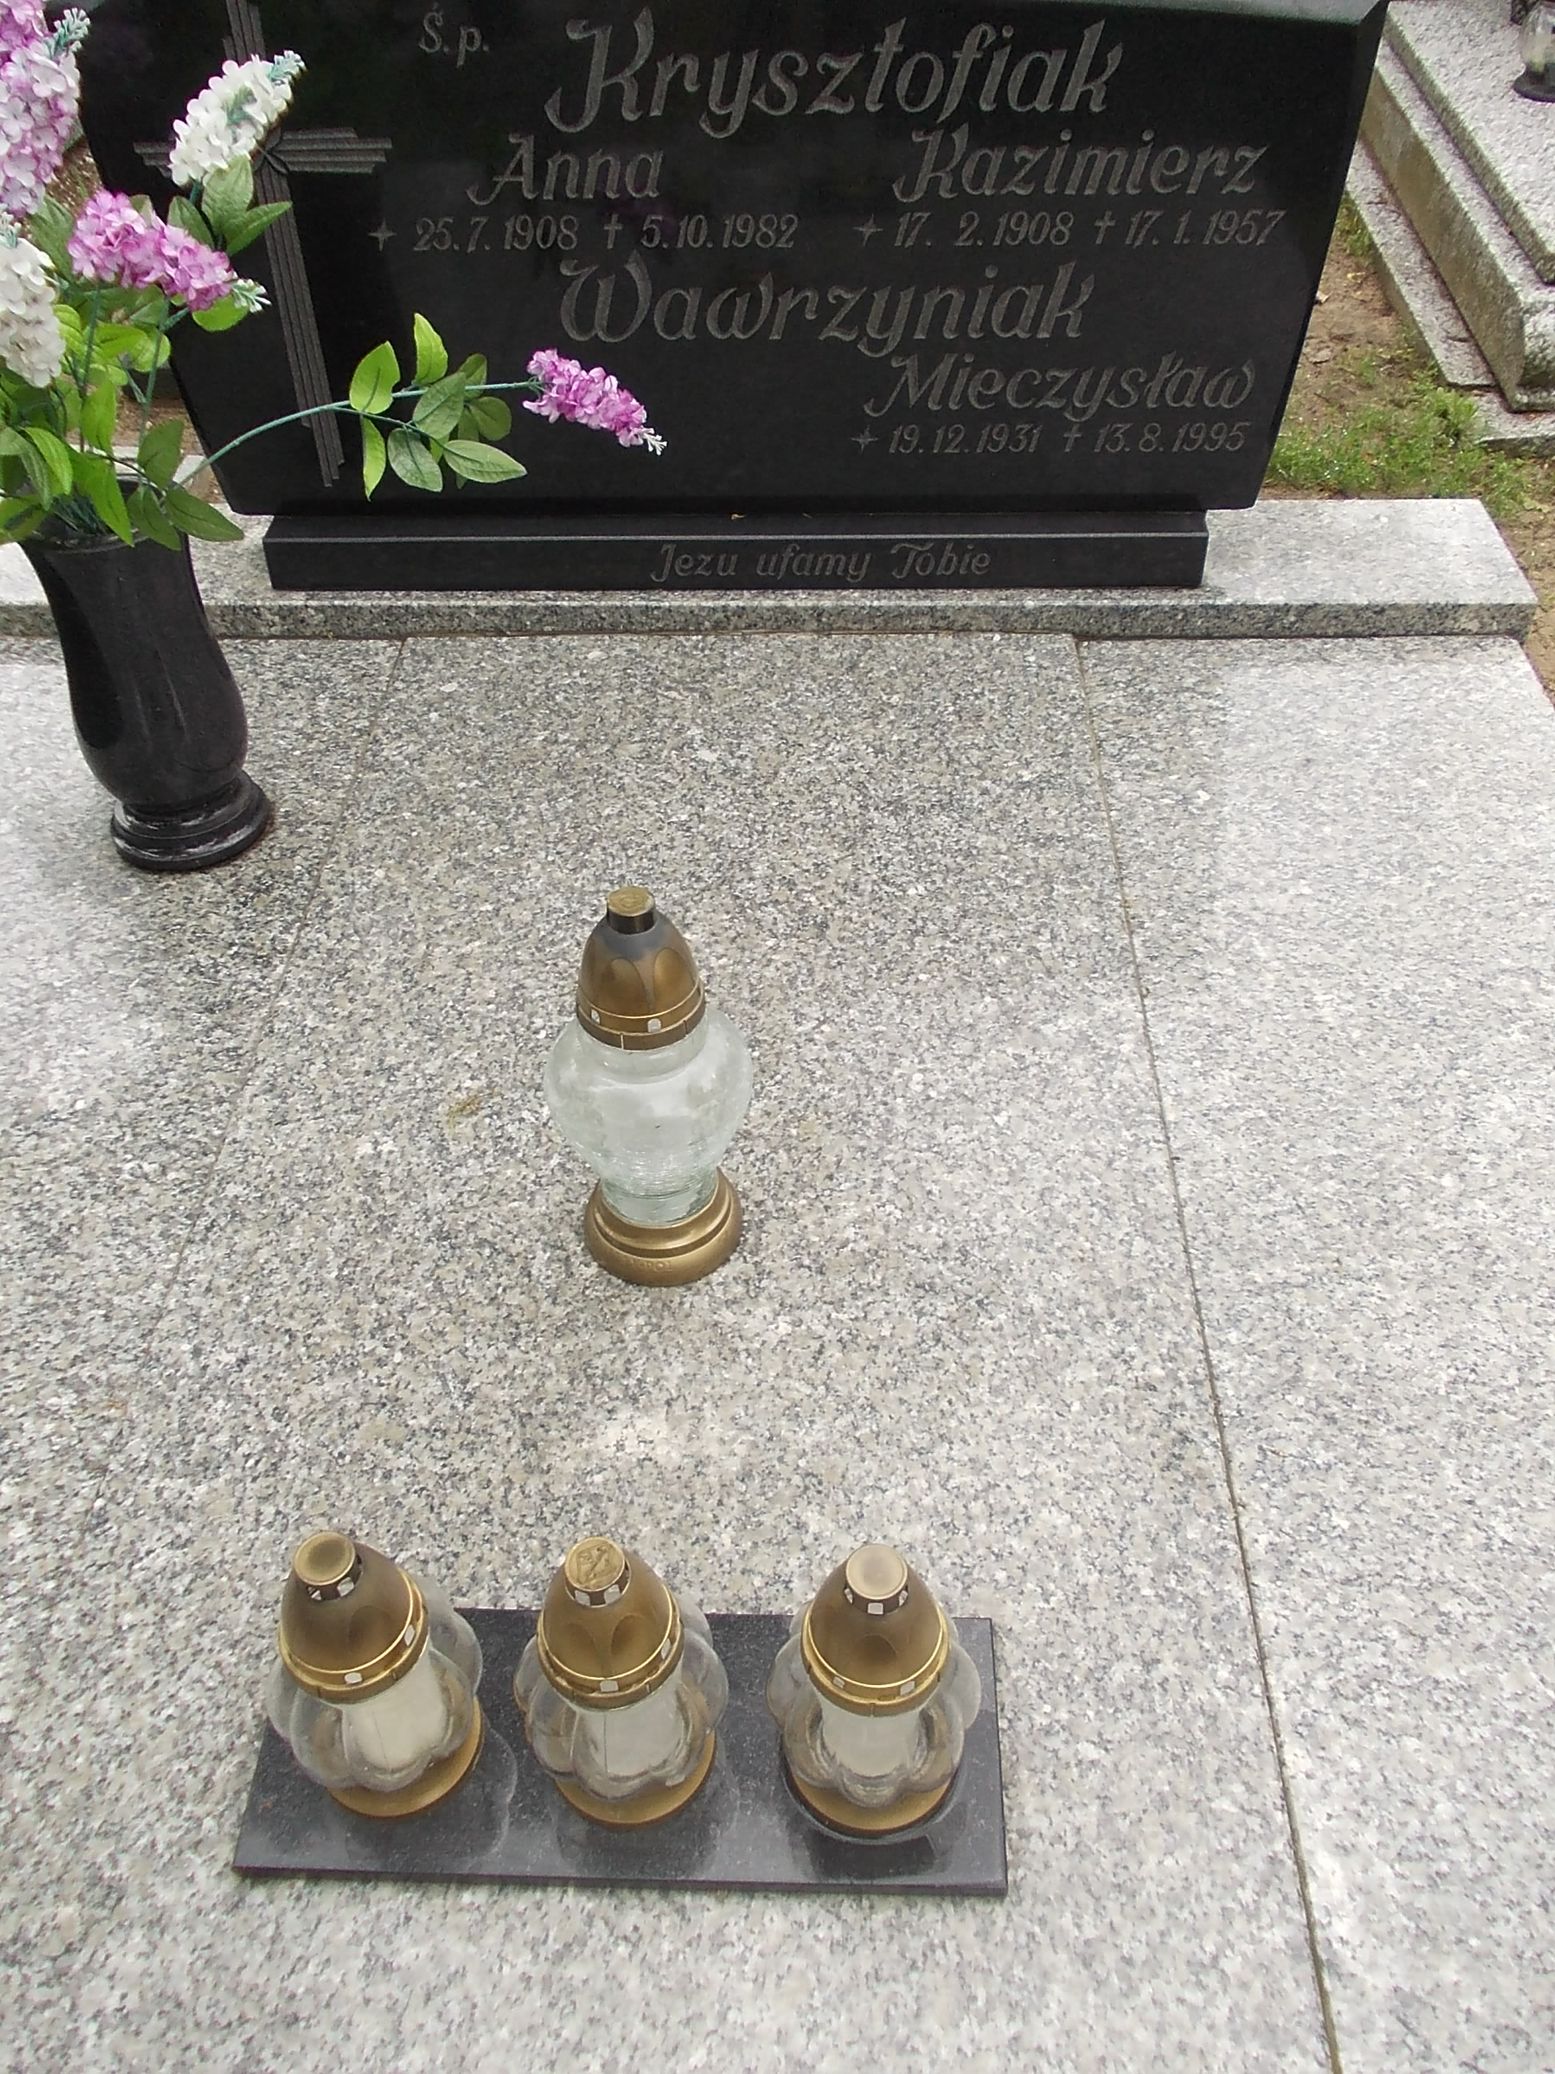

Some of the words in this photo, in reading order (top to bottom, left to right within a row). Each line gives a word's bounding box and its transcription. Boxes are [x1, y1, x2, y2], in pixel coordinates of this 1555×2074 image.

[544, 6, 1123, 139] Krysztofiak
[466, 133, 664, 205] Anna
[892, 122, 1270, 202] Kazimierz
[559, 248, 1095, 357] Wawrzyniak
[863, 351, 1256, 422] Mieczysław
[650, 543, 737, 583] Jezu
[755, 544, 873, 582] ufamy
[890, 542, 992, 580] Tobie
